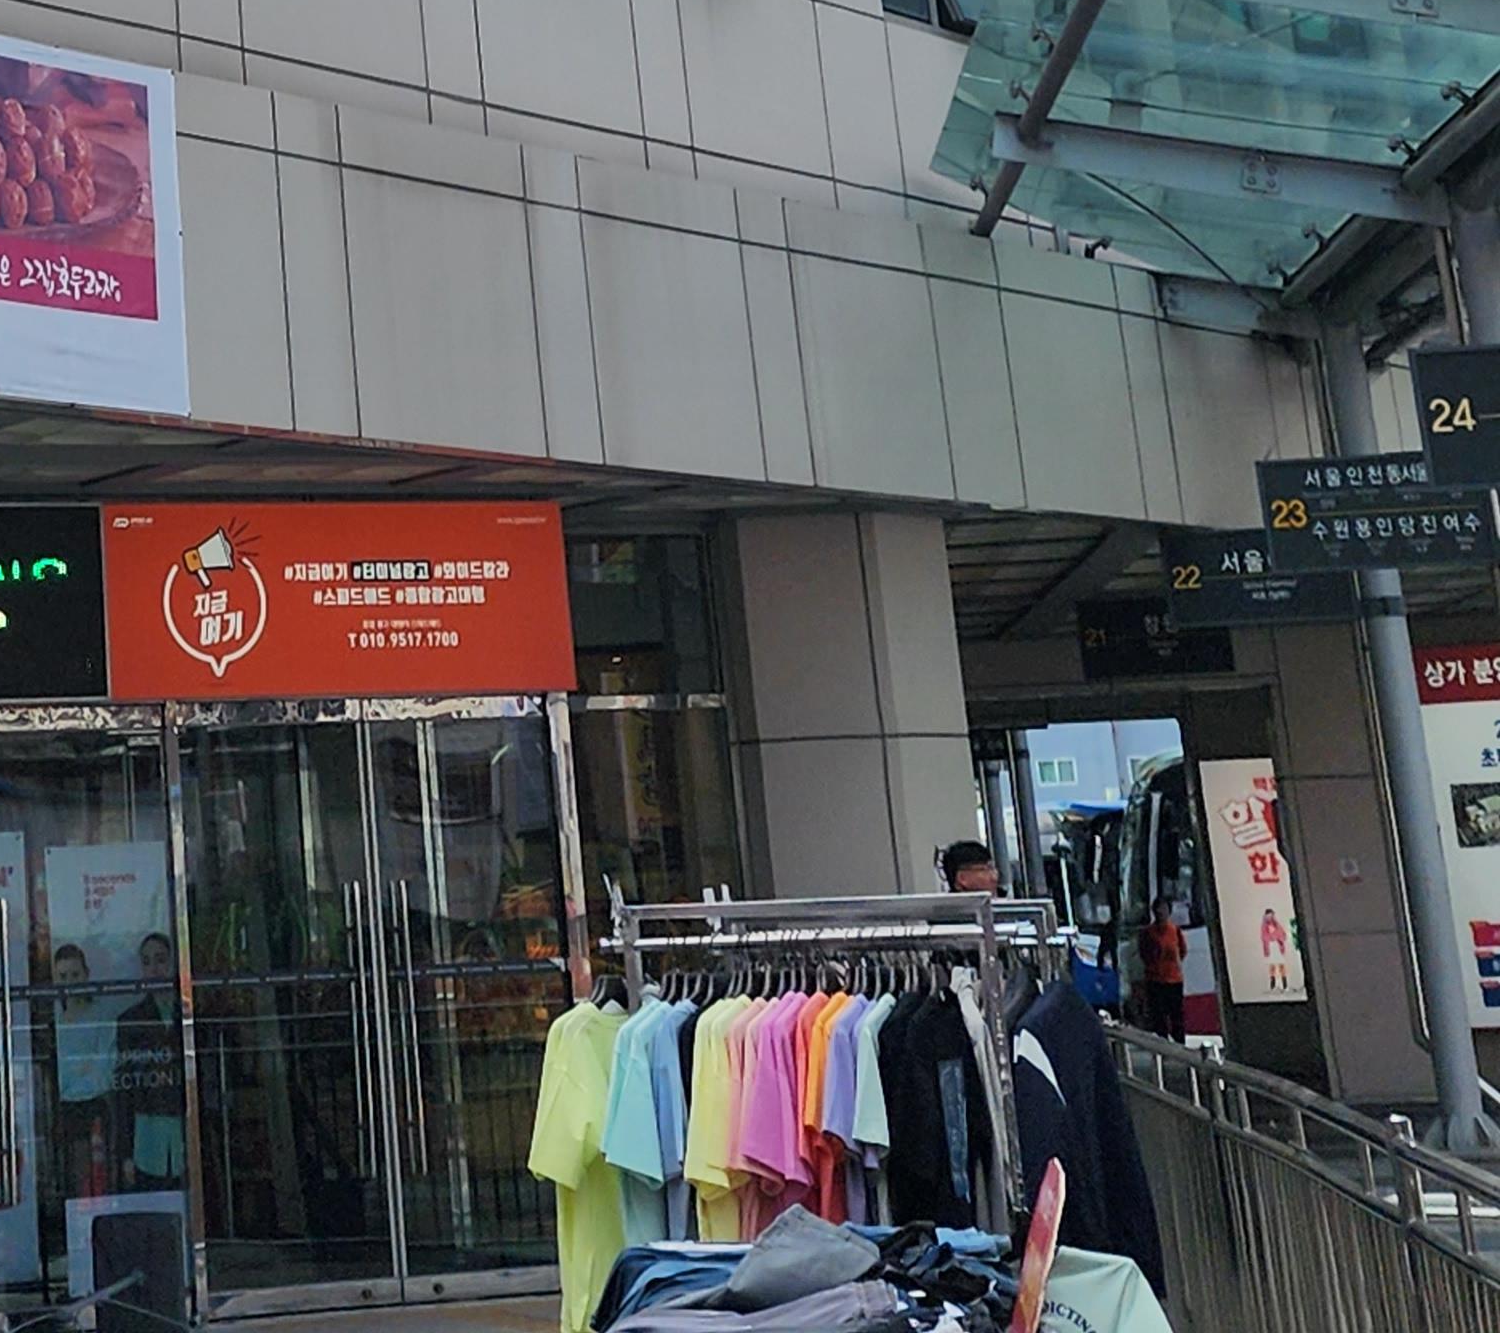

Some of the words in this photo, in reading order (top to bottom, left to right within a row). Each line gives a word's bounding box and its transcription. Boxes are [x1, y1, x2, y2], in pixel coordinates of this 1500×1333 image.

[1429, 398, 1476, 433] 24
[1271, 499, 1307, 529] 23
[1172, 565, 1202, 589] 22
[193, 590, 228, 617] 지금
[199, 611, 244, 646] 여기
[348, 633, 357, 649] T
[359, 632, 459, 649] 010.9517.1700
[1424, 660, 1466, 688] 상가
